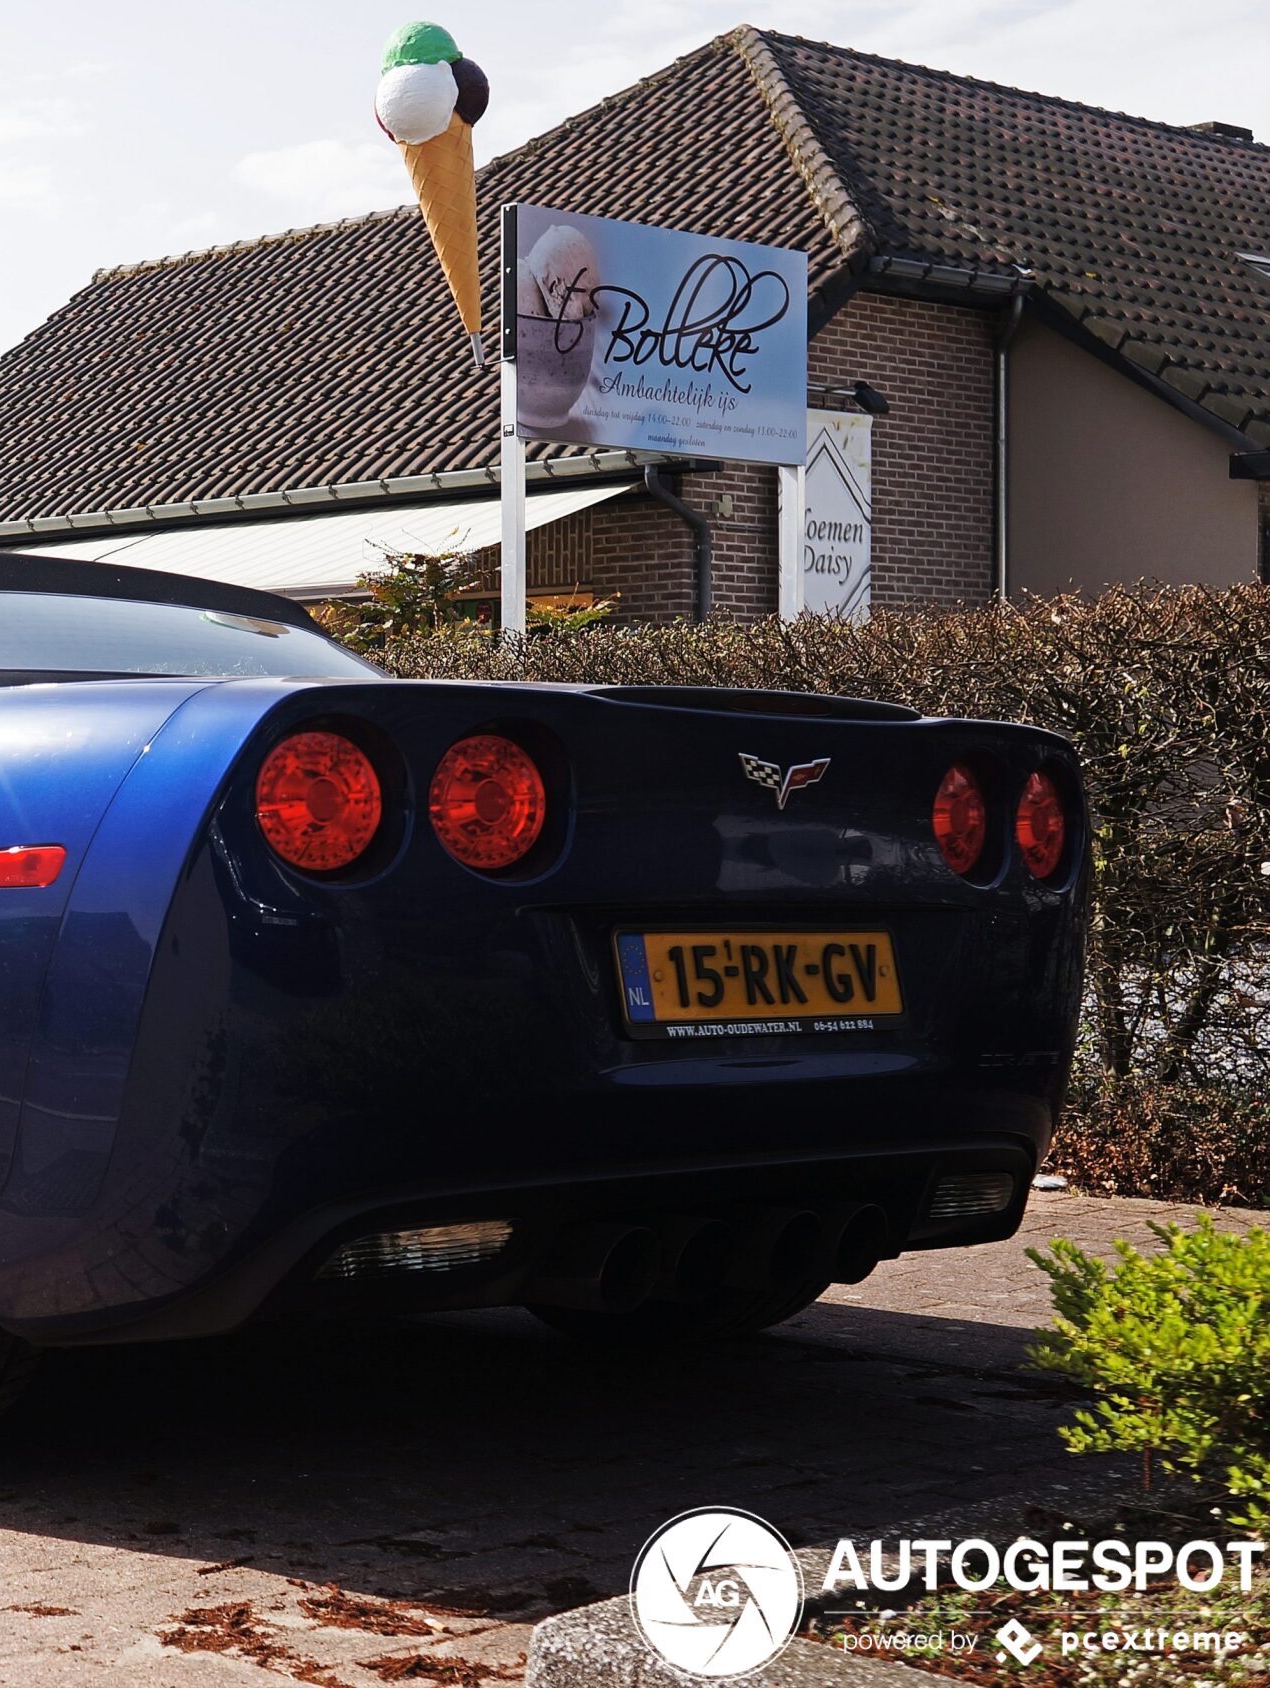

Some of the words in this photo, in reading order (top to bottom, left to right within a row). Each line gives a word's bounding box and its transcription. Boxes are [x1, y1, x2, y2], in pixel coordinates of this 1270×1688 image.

[590, 253, 790, 394] Bolleke
[599, 371, 714, 414] Ambachtelijk
[718, 390, 739, 417] ijs
[583, 406, 609, 420] dinsdag
[611, 410, 620, 419] tot
[622, 411, 645, 425] vrijdag
[696, 420, 722, 433] zaterdag
[733, 423, 755, 438] zondag
[647, 433, 676, 447] maandag
[679, 434, 706, 448] gesloten
[804, 545, 852, 585] Daisy
[667, 943, 877, 1008] 15-RK-GV
[628, 987, 650, 1007] NL
[666, 1021, 803, 1037] WWW.AUTO-OUDEWATER.NL
[813, 1021, 839, 1032] 06-54
[839, 1020, 856, 1030] 622
[857, 1019, 874, 1030] 884
